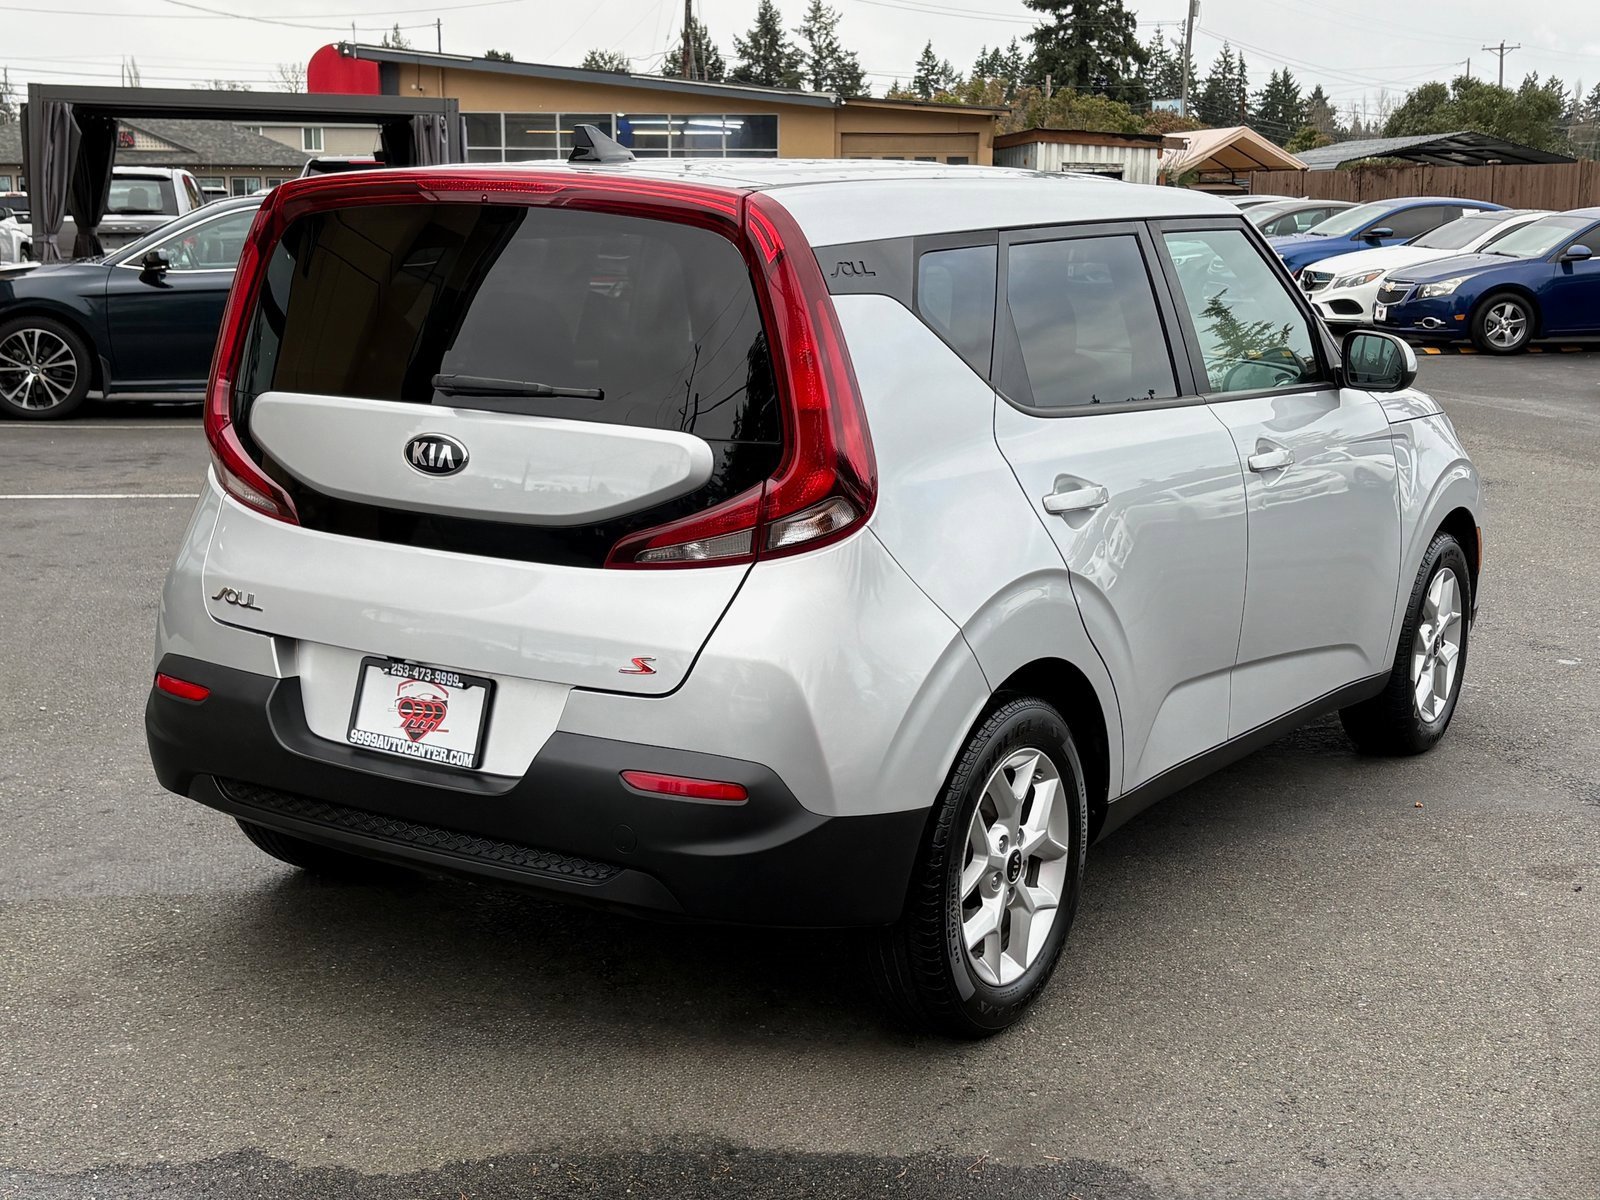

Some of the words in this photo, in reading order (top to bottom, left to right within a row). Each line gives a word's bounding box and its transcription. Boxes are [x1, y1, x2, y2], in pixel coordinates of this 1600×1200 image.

[412, 441, 456, 469] KIA
[212, 587, 263, 612] SOUL
[391, 663, 460, 687] 253-473-9999
[618, 657, 656, 674] S
[350, 729, 474, 768] 9999AUTOCENTER.COM
[1011, 854, 1020, 880] KIA
